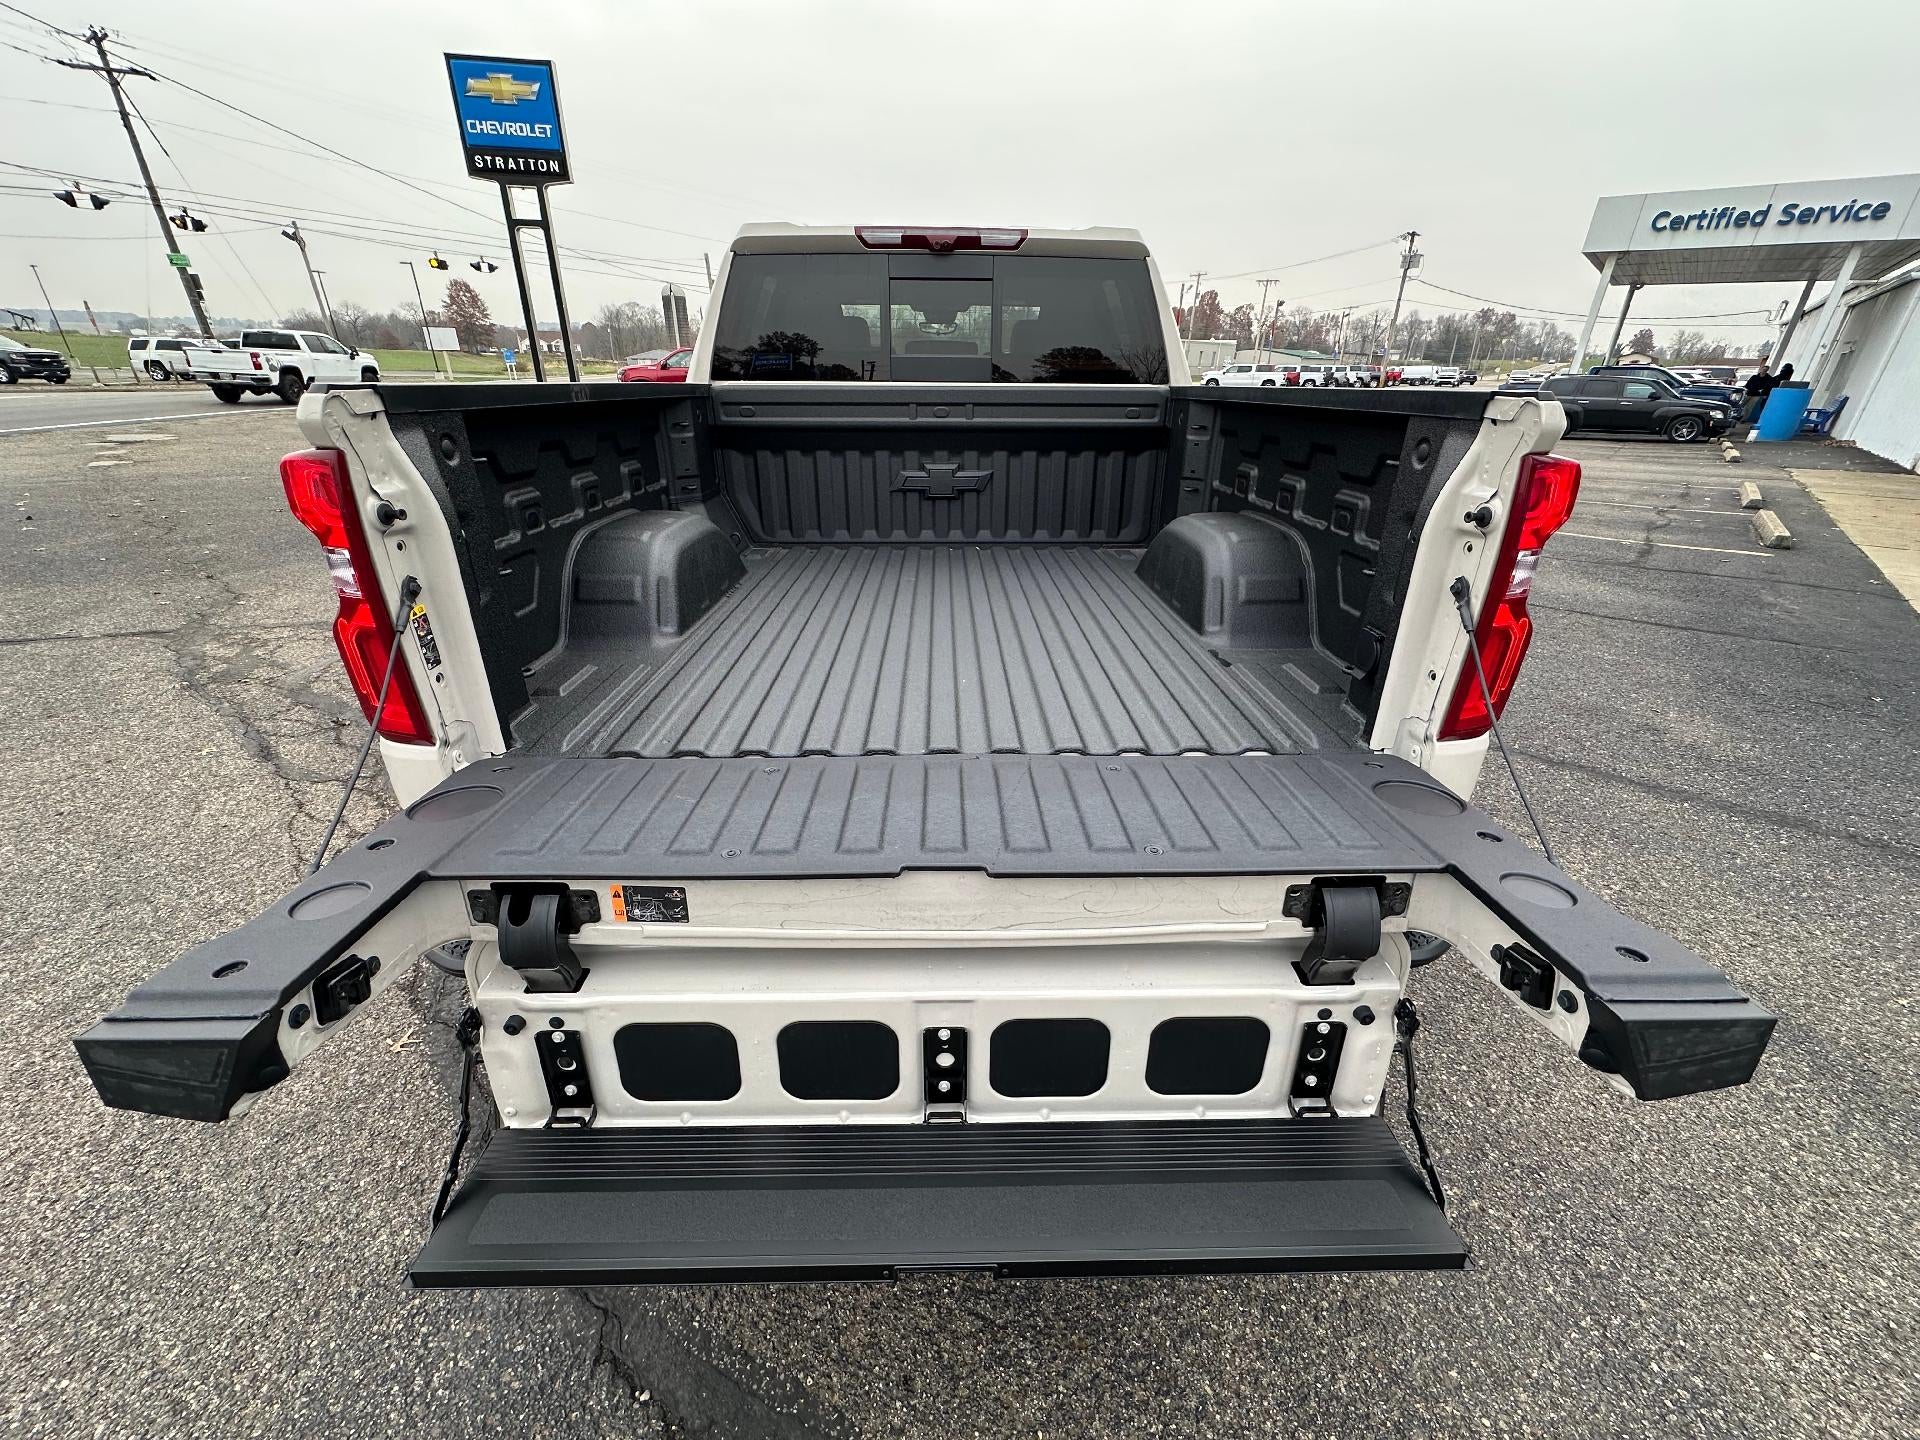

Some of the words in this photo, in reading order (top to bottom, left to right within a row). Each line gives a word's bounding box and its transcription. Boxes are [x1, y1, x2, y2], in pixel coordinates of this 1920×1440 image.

[466, 120, 552, 137] CHEVROLET
[474, 155, 560, 172] STRATTON
[1651, 204, 1772, 232] Certified
[1776, 199, 1891, 226] Service
